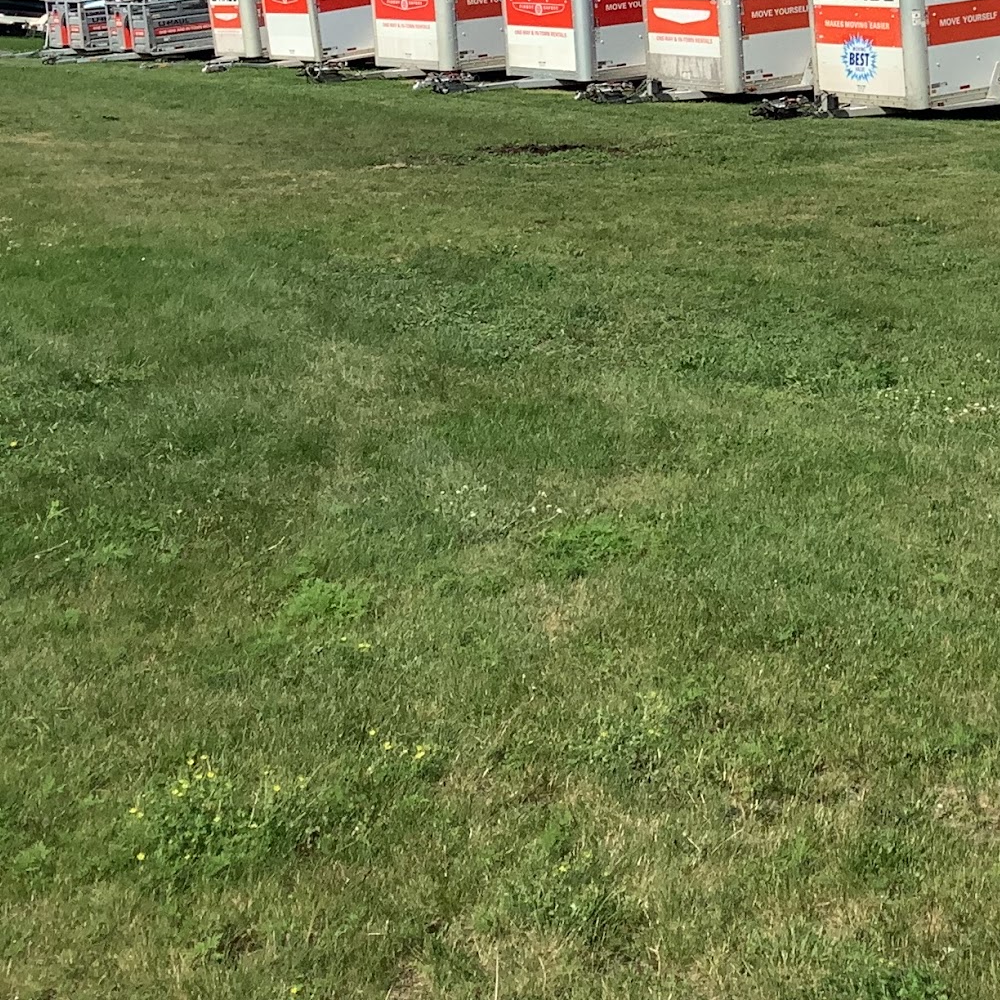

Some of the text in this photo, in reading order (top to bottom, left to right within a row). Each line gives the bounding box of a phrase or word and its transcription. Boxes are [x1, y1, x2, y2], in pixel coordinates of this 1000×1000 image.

[605, 2, 628, 11] MOVE
[751, 9, 774, 19] MOVE
[939, 16, 961, 27] MOVE
[962, 11, 998, 24] YOURSELF
[824, 19, 890, 30] MAKES MOVING EASIER
[849, 52, 870, 67] BEST
